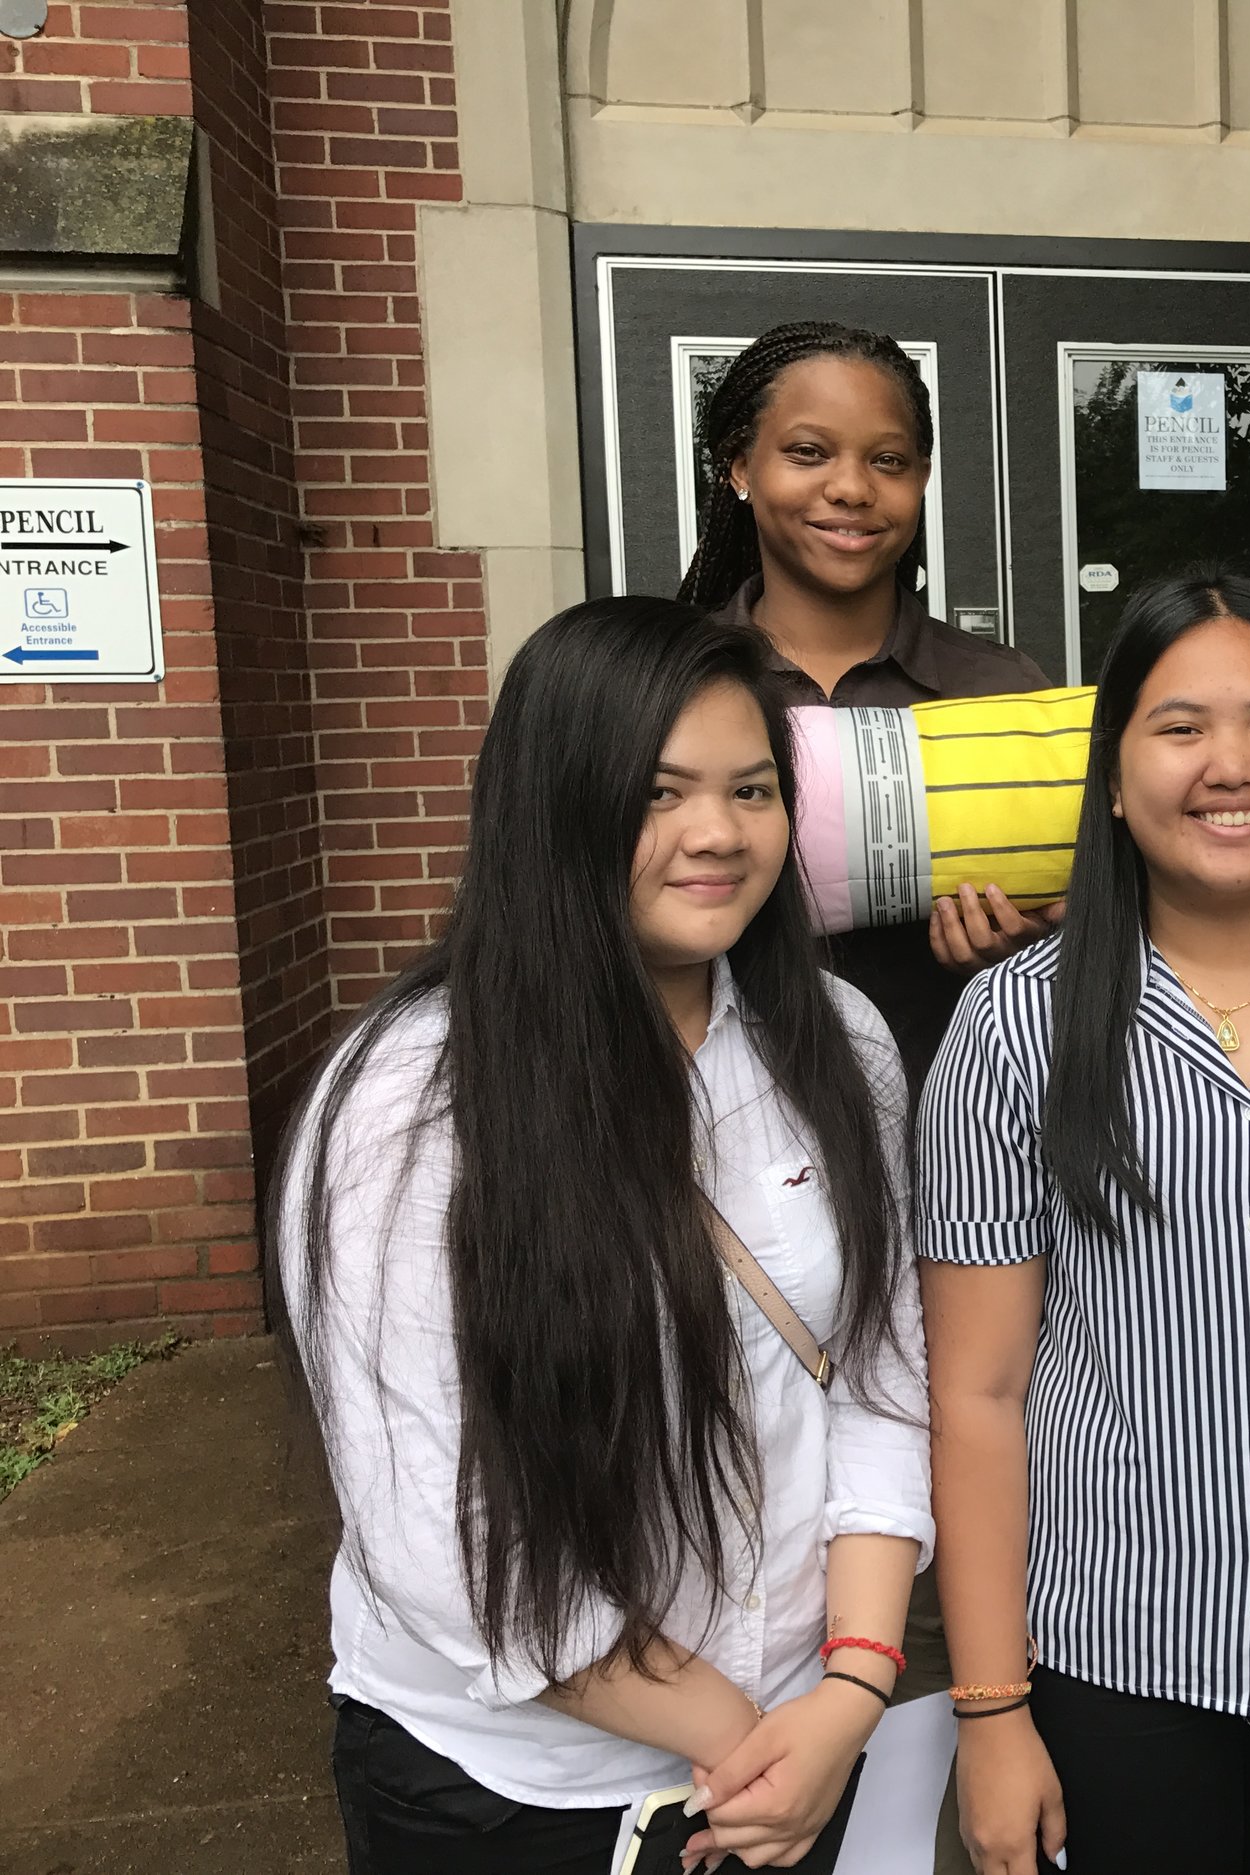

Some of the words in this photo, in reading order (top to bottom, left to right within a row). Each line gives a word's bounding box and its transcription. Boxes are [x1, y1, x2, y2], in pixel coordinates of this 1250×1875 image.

[1144, 416, 1219, 433] PENCIL
[1170, 436, 1218, 444] ENTRANCE
[1150, 445, 1159, 453] IS
[1161, 445, 1179, 453] FOR
[1146, 455, 1175, 463] STAFF
[1176, 455, 1182, 463] &
[1170, 465, 1194, 473] ONLY
[0, 510, 104, 533] PENCIL
[0, 560, 108, 576] NTRANCE
[21, 623, 77, 632] Accessible
[26, 635, 73, 645] Entrance
